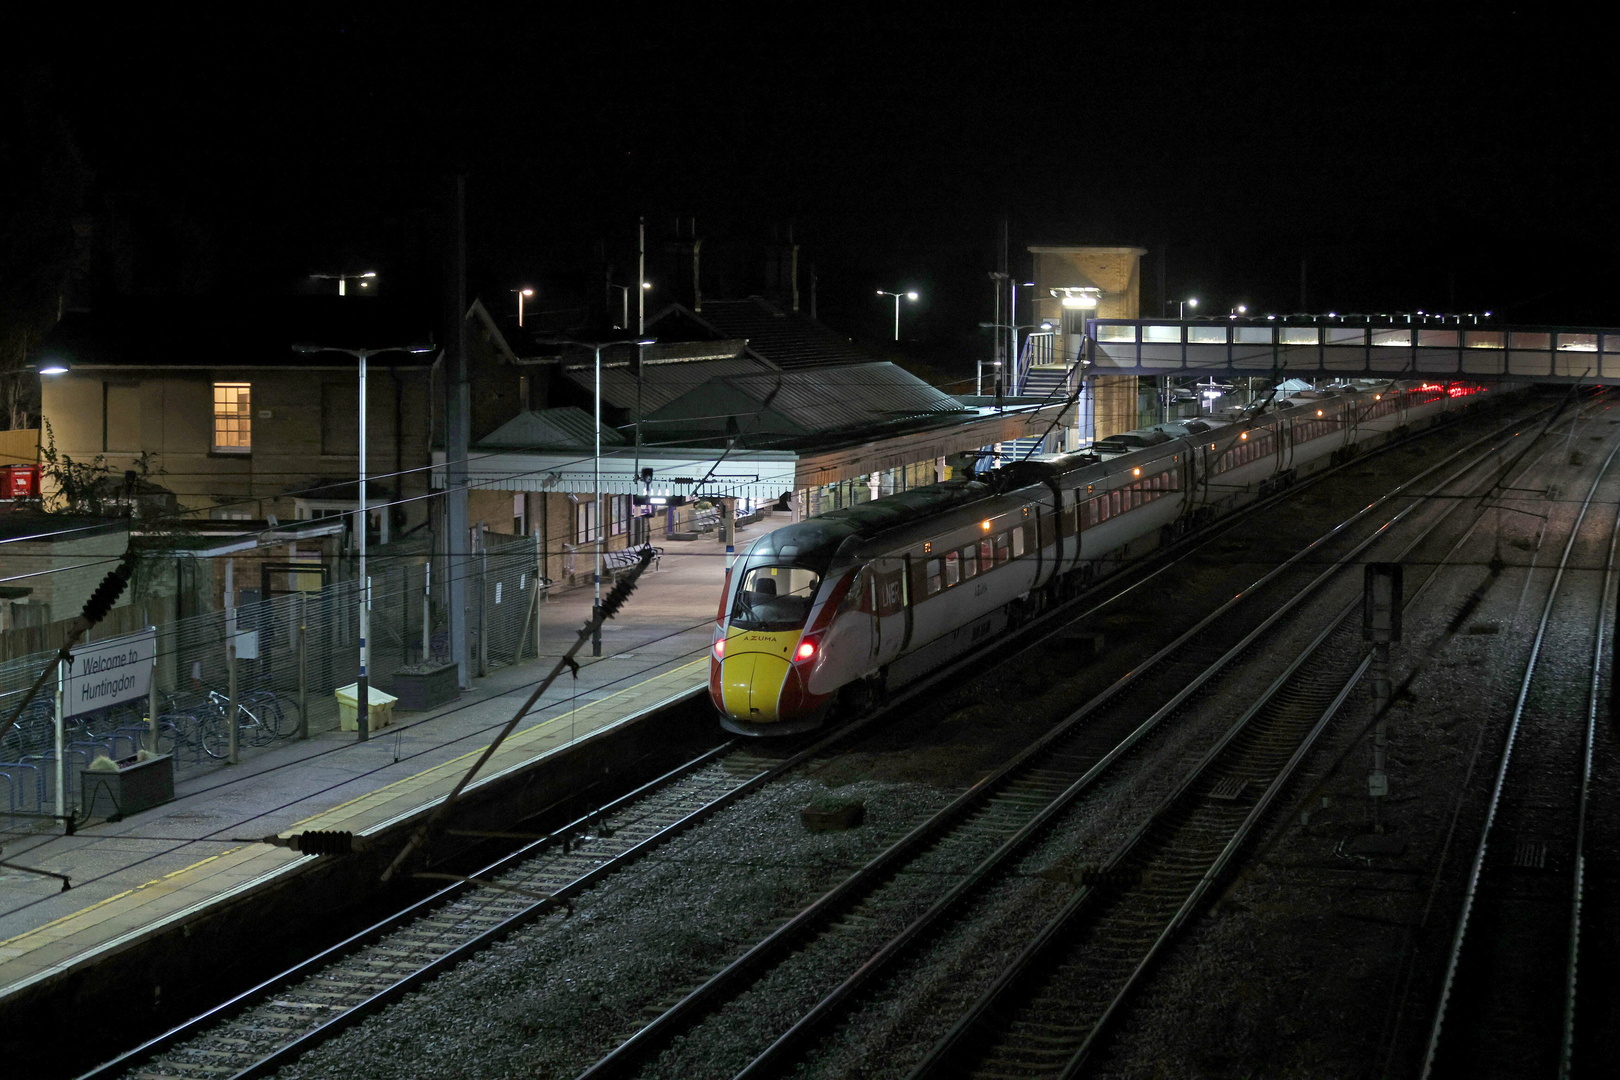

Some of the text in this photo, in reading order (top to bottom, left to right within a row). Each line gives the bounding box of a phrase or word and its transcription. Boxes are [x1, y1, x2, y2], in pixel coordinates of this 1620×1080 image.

[83, 649, 138, 675] Welcome to
[82, 673, 135, 701] Huntingdon
